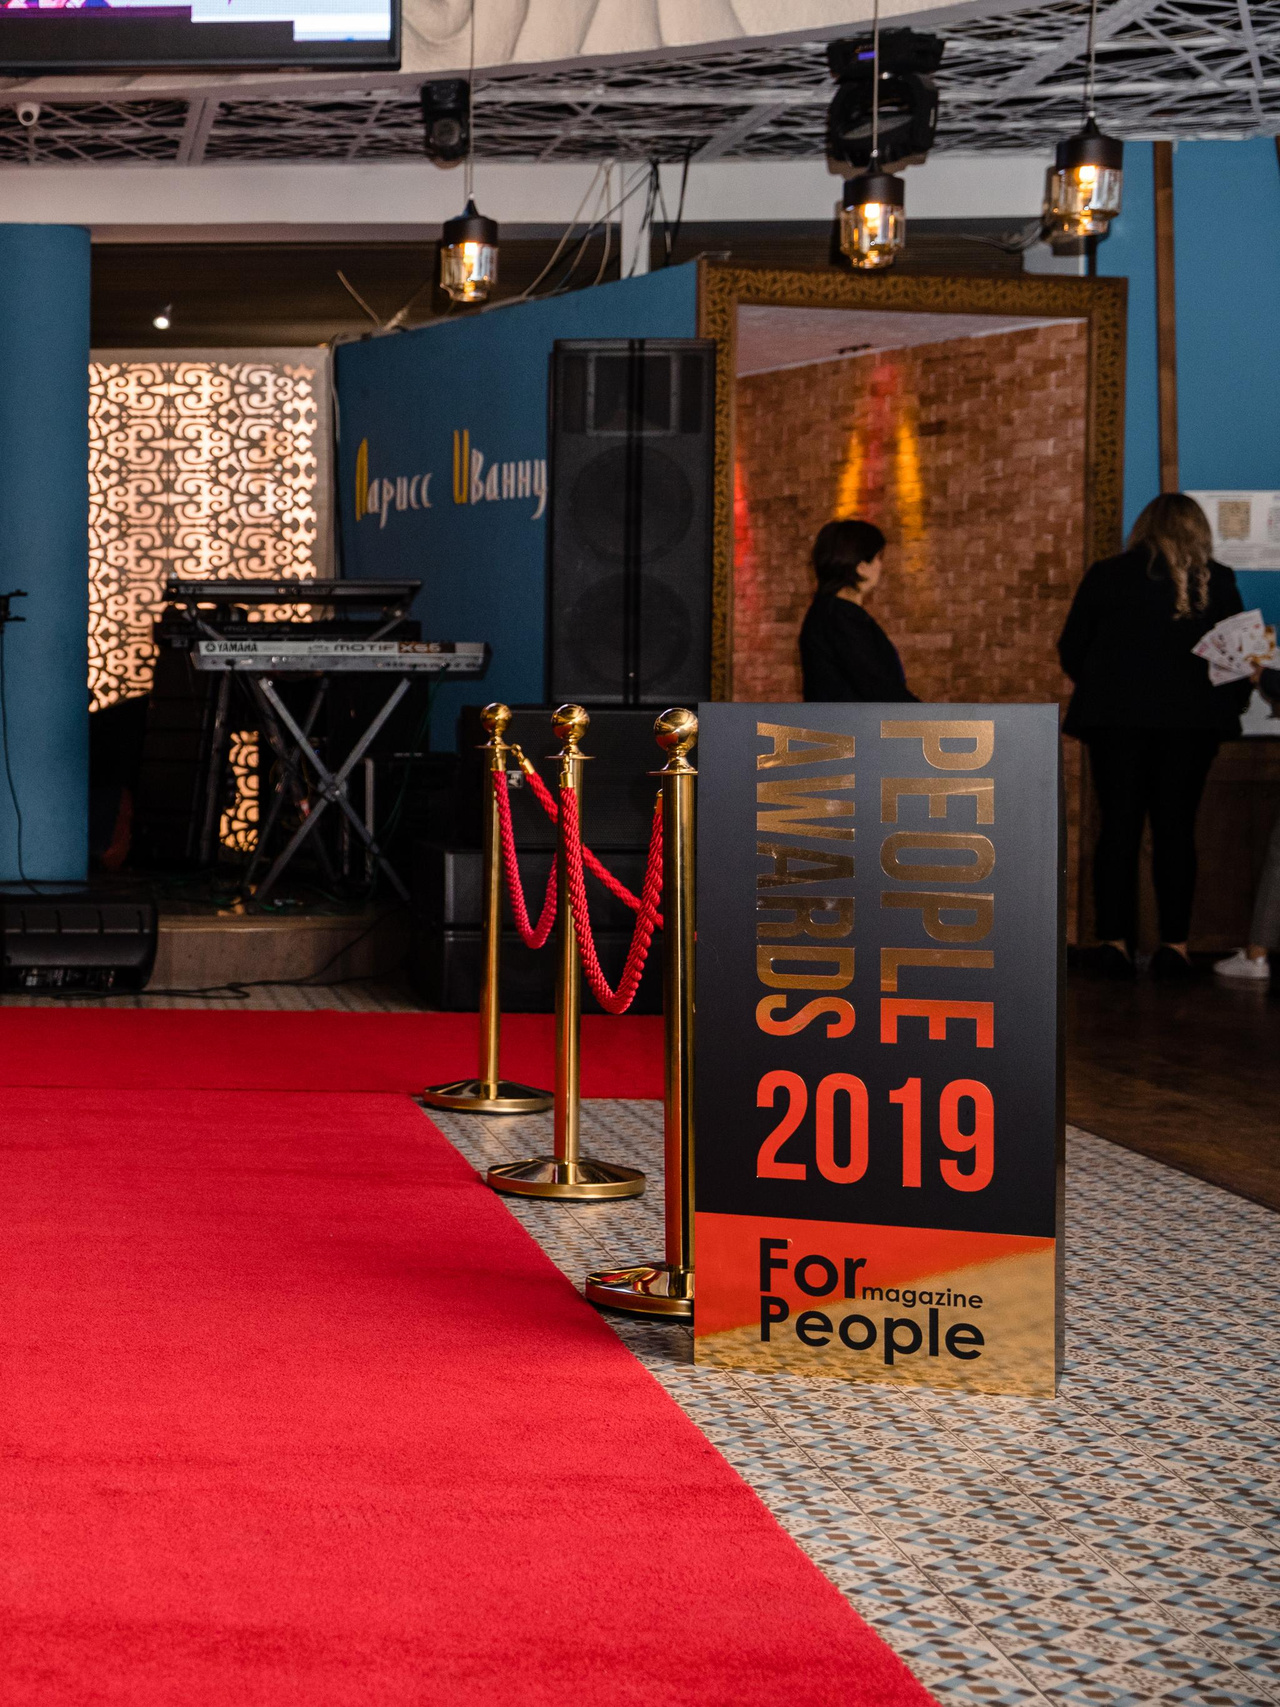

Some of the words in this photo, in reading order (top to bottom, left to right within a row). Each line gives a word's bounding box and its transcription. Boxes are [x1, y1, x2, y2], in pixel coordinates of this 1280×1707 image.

[217, 643, 258, 652] YAMAHA
[756, 722, 856, 1039] AWARDS
[880, 720, 995, 1048] PEOPLE
[756, 1069, 995, 1193] 2019
[760, 1237, 868, 1300] For
[862, 1286, 984, 1309] magazine
[760, 1295, 985, 1366] People
